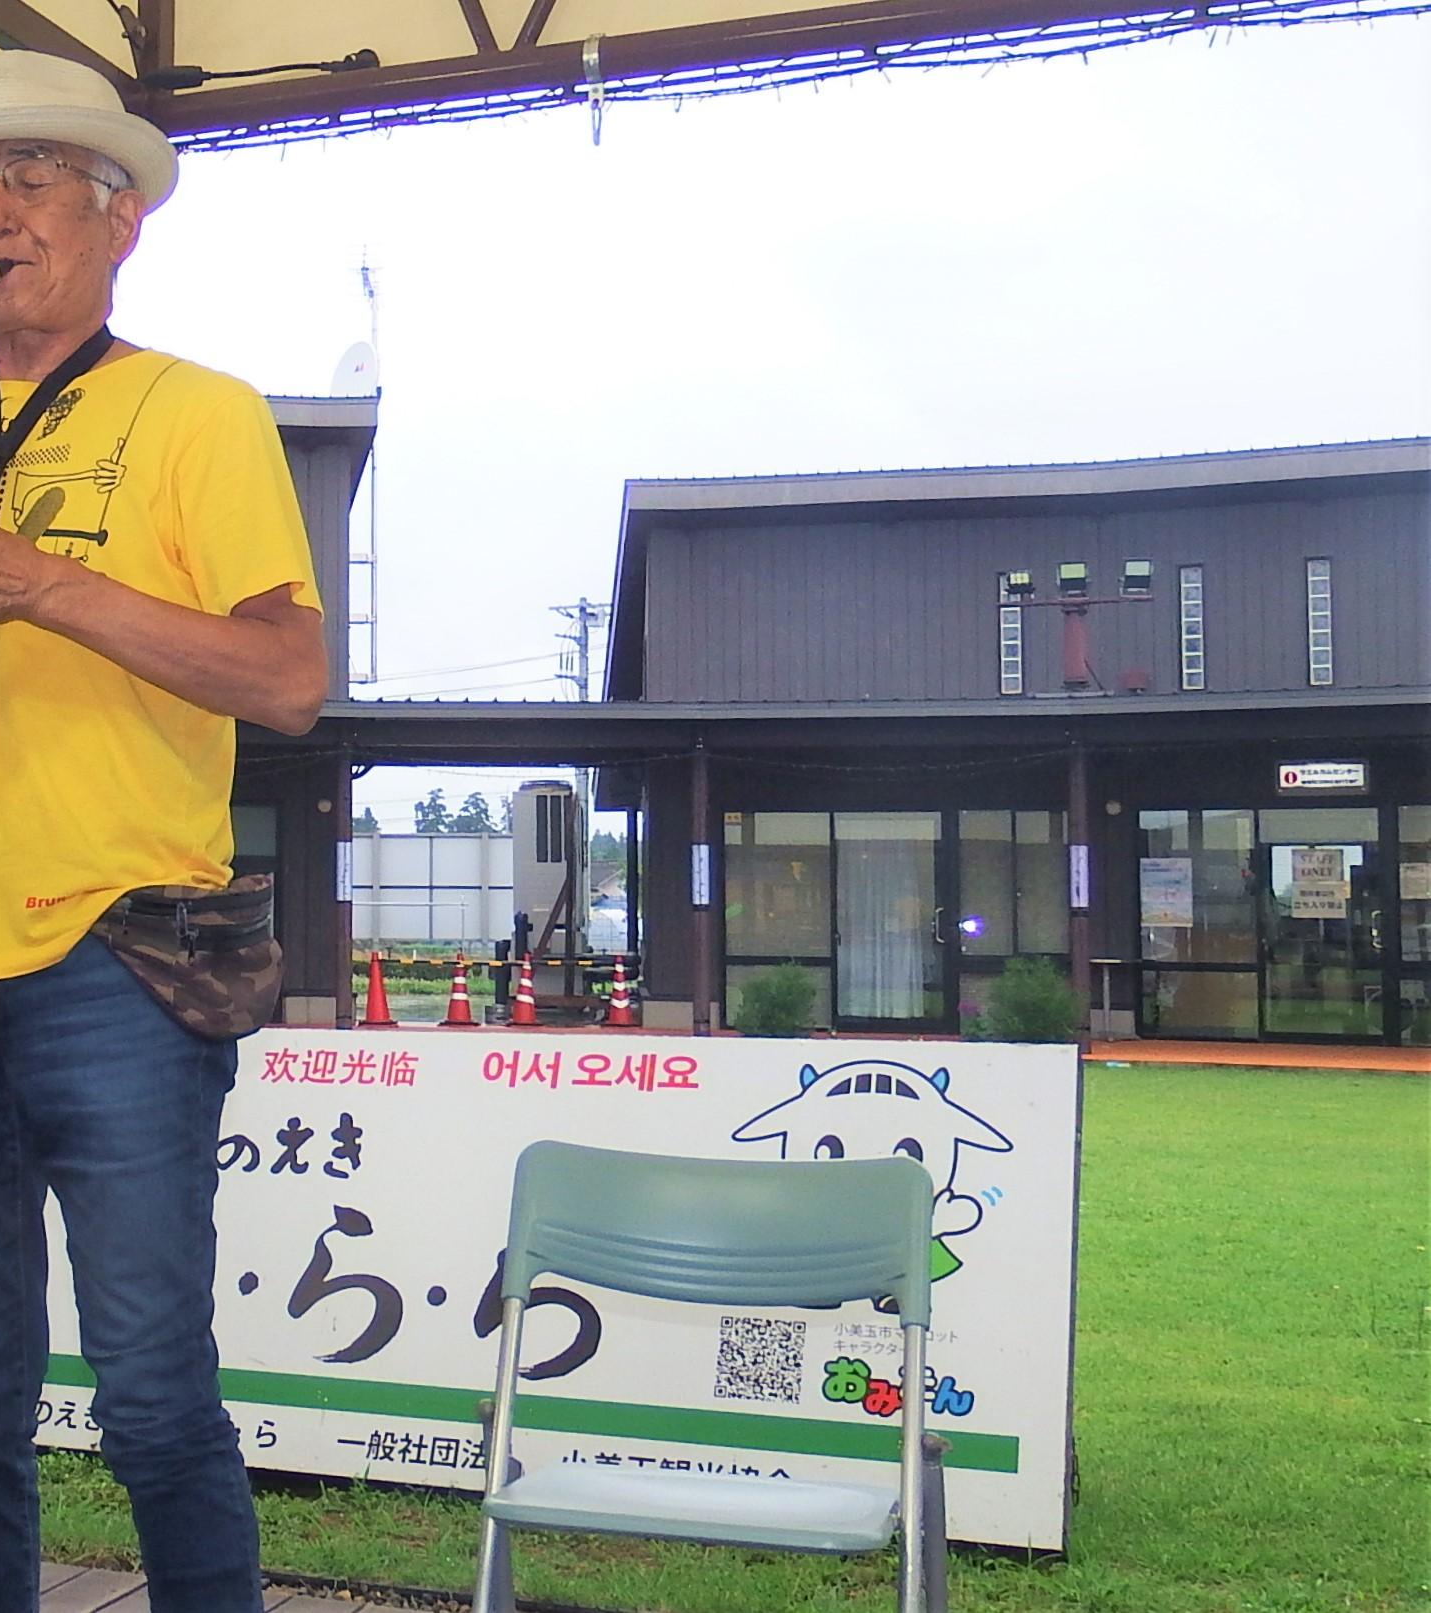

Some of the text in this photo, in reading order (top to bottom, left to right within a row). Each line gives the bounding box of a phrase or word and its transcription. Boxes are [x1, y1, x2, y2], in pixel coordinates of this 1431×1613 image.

[261, 1049, 419, 1087] 欢迎光临
[482, 1050, 700, 1092] 어서 오세요
[834, 1322, 958, 1343] 小美玉市マコット
